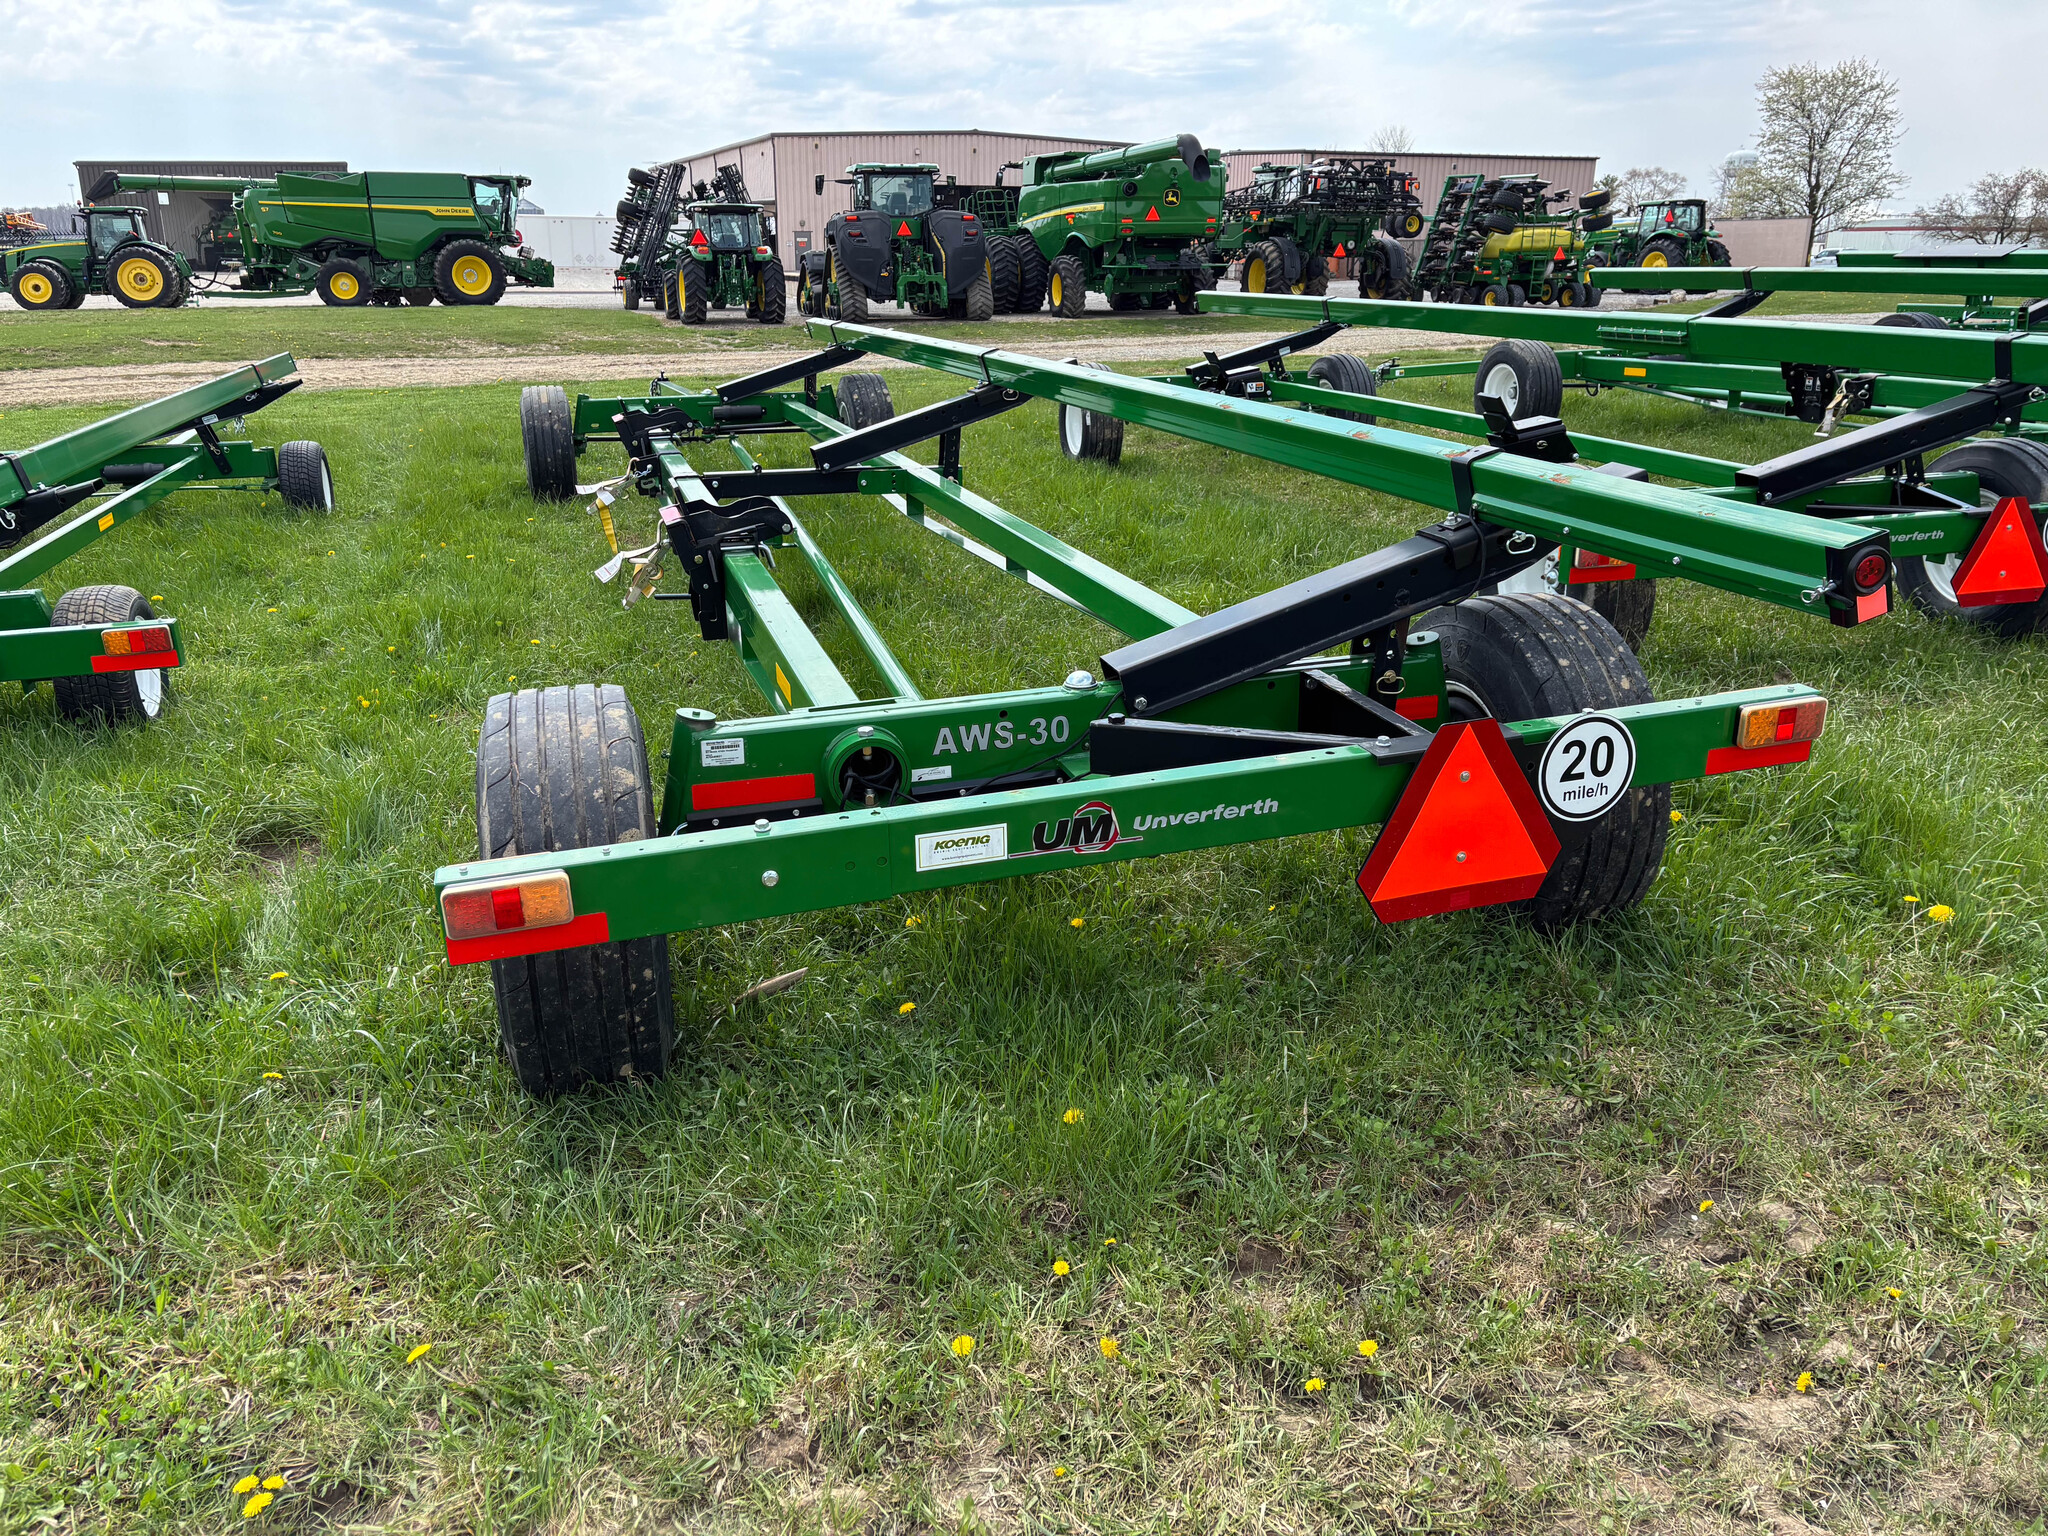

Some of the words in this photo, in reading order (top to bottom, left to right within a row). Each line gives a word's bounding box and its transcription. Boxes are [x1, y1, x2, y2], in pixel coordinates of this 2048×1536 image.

[1889, 529, 1945, 543] verferth
[932, 715, 1070, 756] AWS-30
[1559, 735, 1615, 783] 20
[1562, 782, 1609, 802] mile/h
[1032, 812, 1115, 851] UM
[1132, 797, 1279, 831] Unverferth
